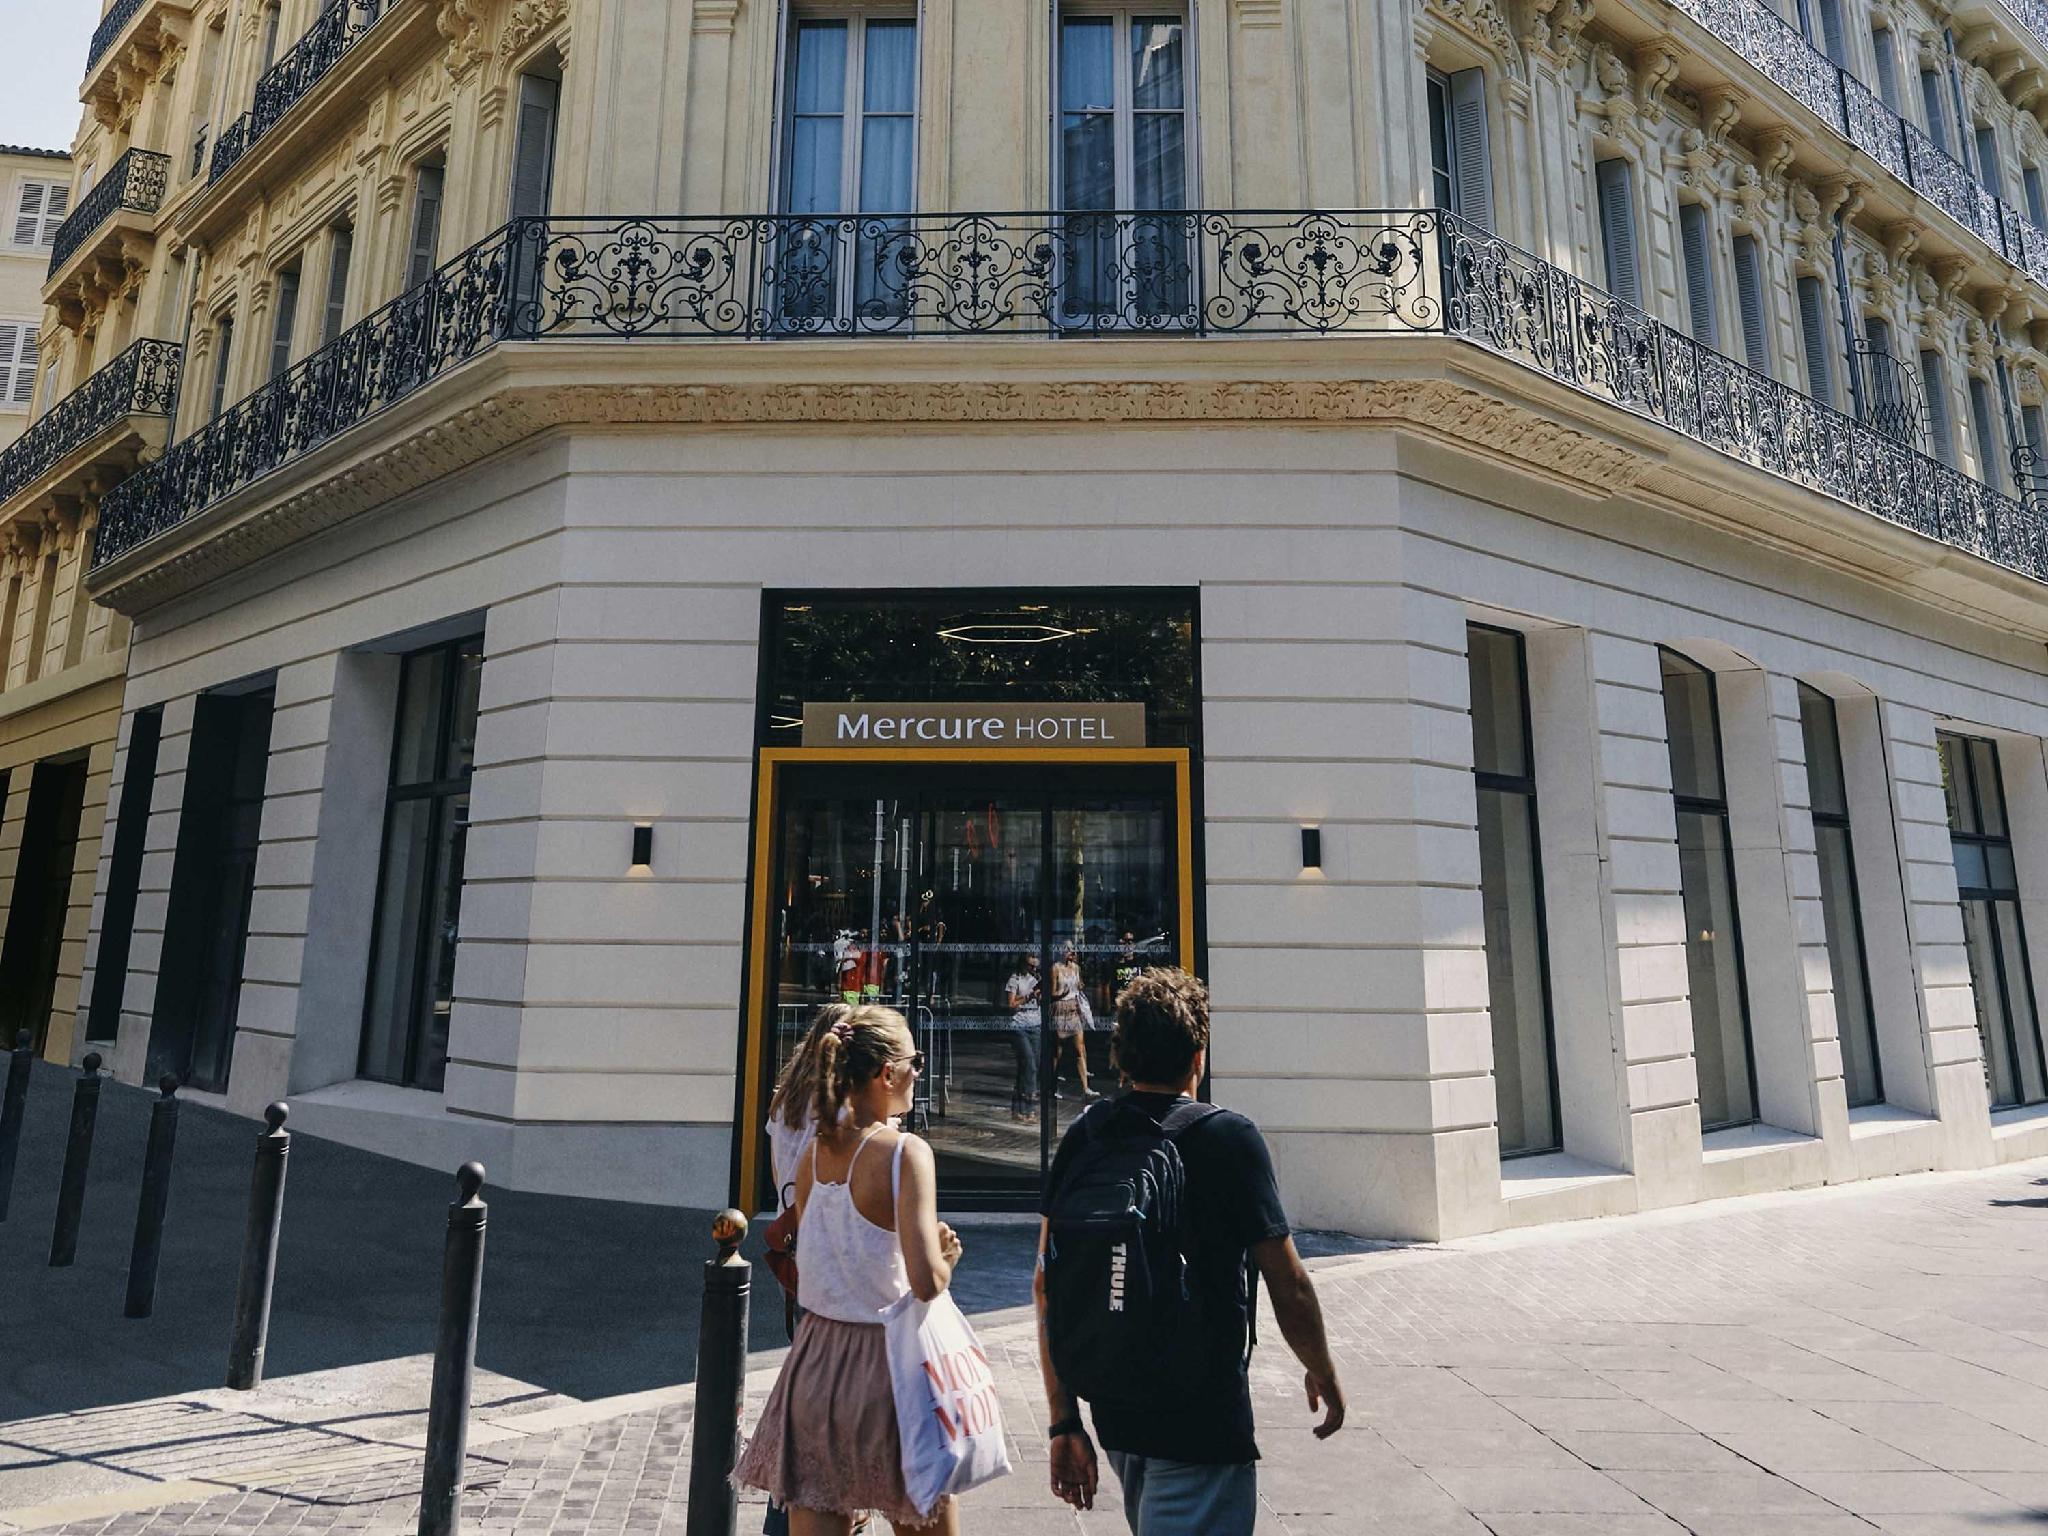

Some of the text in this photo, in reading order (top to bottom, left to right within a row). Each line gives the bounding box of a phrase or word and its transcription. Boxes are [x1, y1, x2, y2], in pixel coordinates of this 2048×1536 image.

[837, 713, 1115, 740] Mercure HOTEL
[1108, 1242, 1127, 1312] THULE
